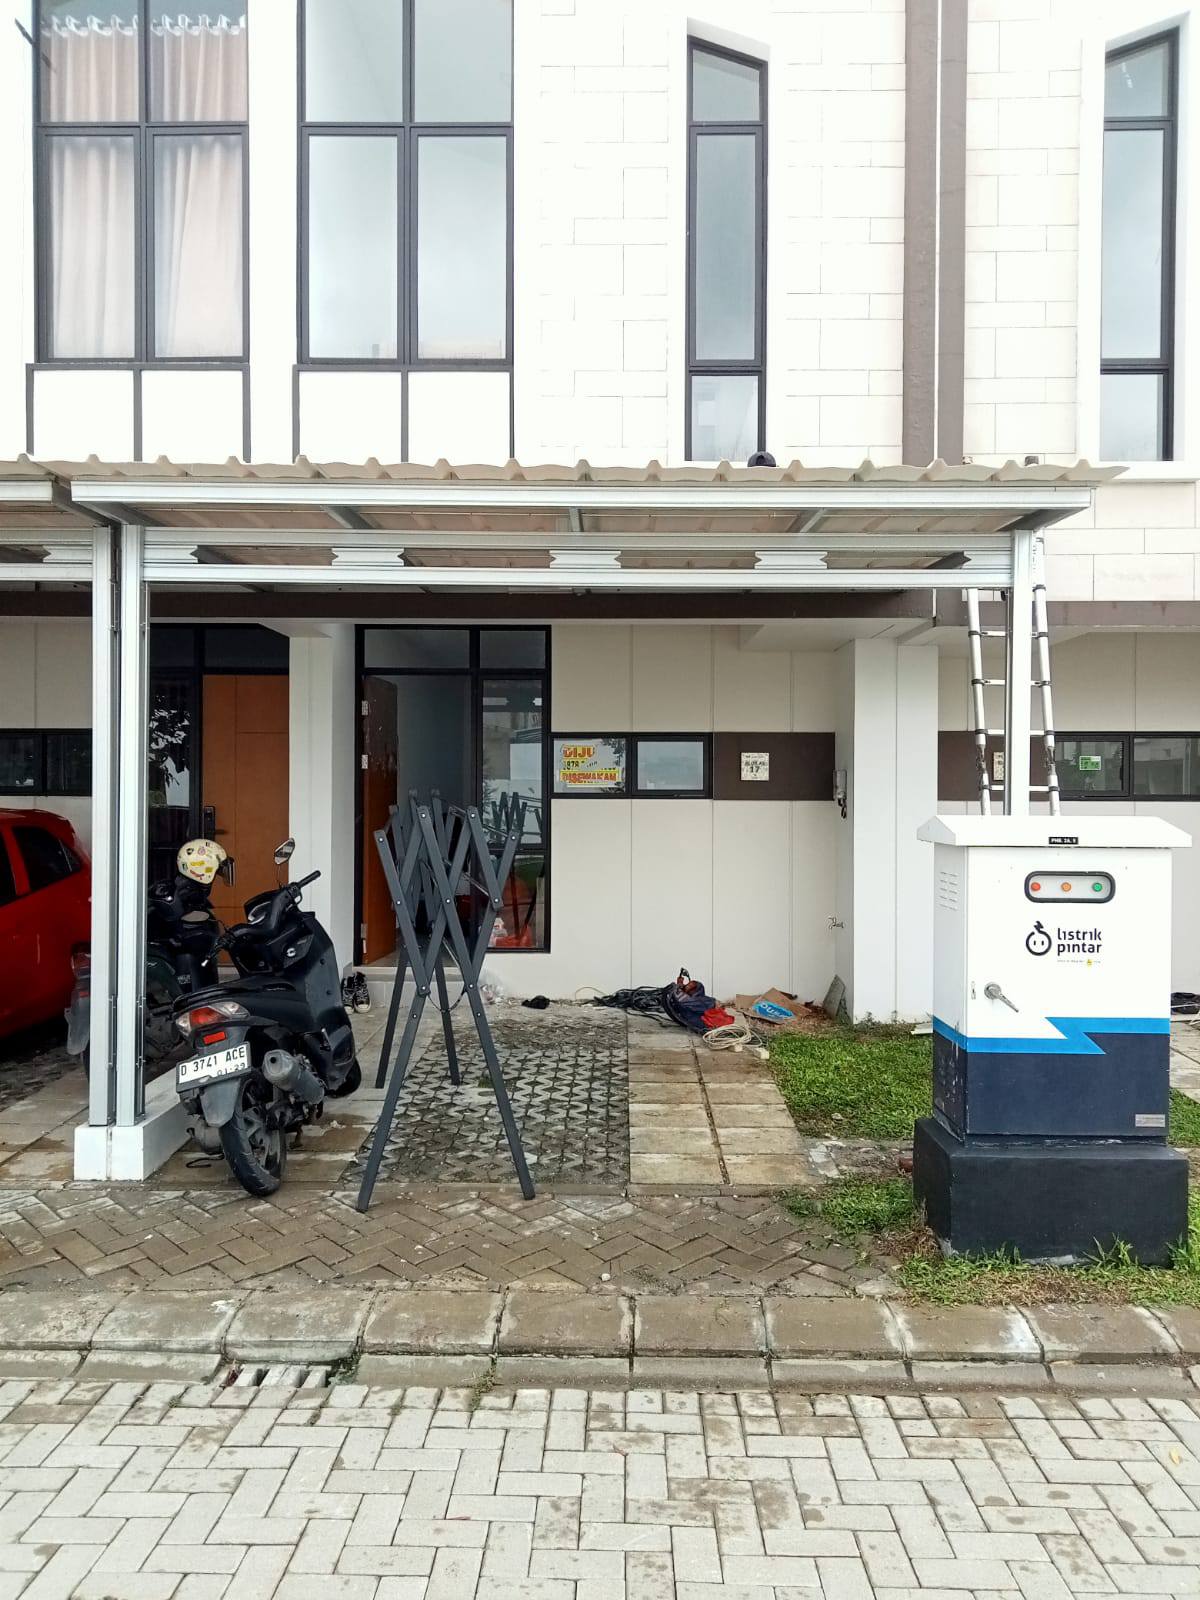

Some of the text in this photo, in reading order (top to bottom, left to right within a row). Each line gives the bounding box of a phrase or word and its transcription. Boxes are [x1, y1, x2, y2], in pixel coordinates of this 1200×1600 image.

[1057, 927, 1102, 941] listrik
[1057, 942, 1102, 956] pintar
[180, 1046, 245, 1076] D 3741 ACE
